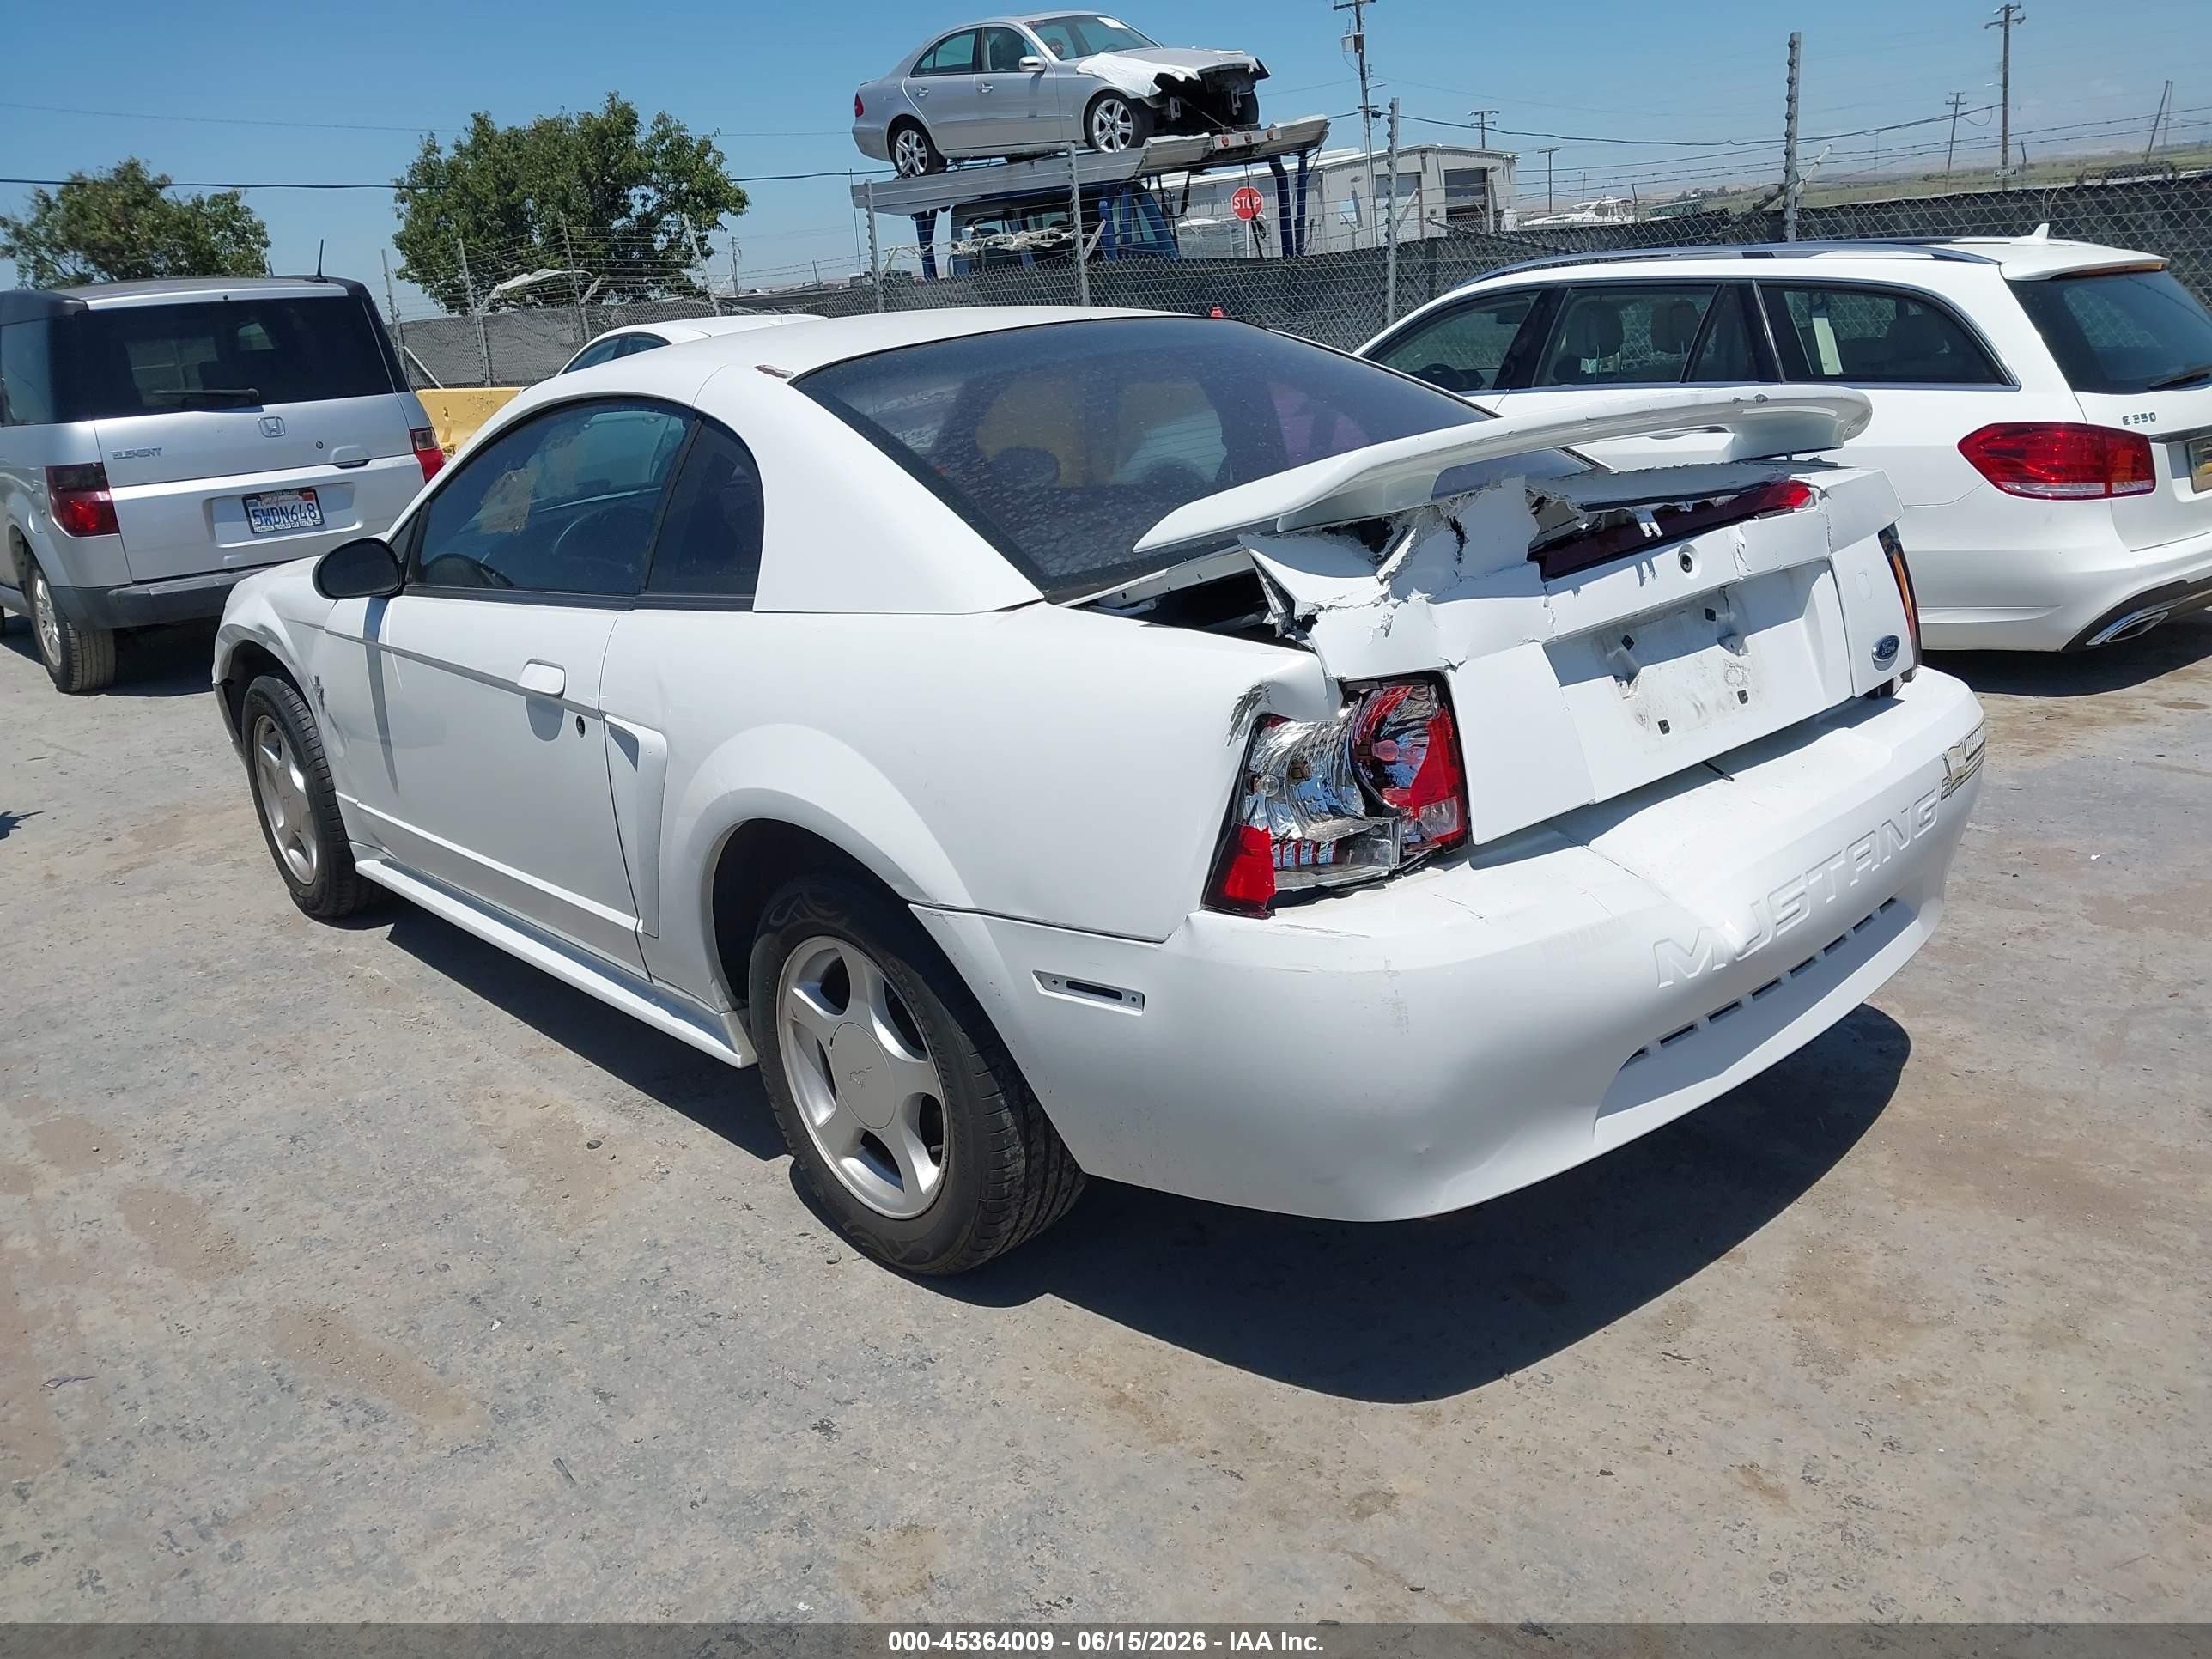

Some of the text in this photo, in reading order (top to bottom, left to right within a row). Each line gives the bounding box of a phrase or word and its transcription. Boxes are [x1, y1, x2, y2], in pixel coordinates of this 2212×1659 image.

[1233, 196, 1261, 210] STOP
[2122, 411, 2157, 426] E 350
[112, 447, 161, 459] ELEMENT
[252, 502, 317, 526] 5WDN648
[1652, 787, 1939, 989] MUSTANG
